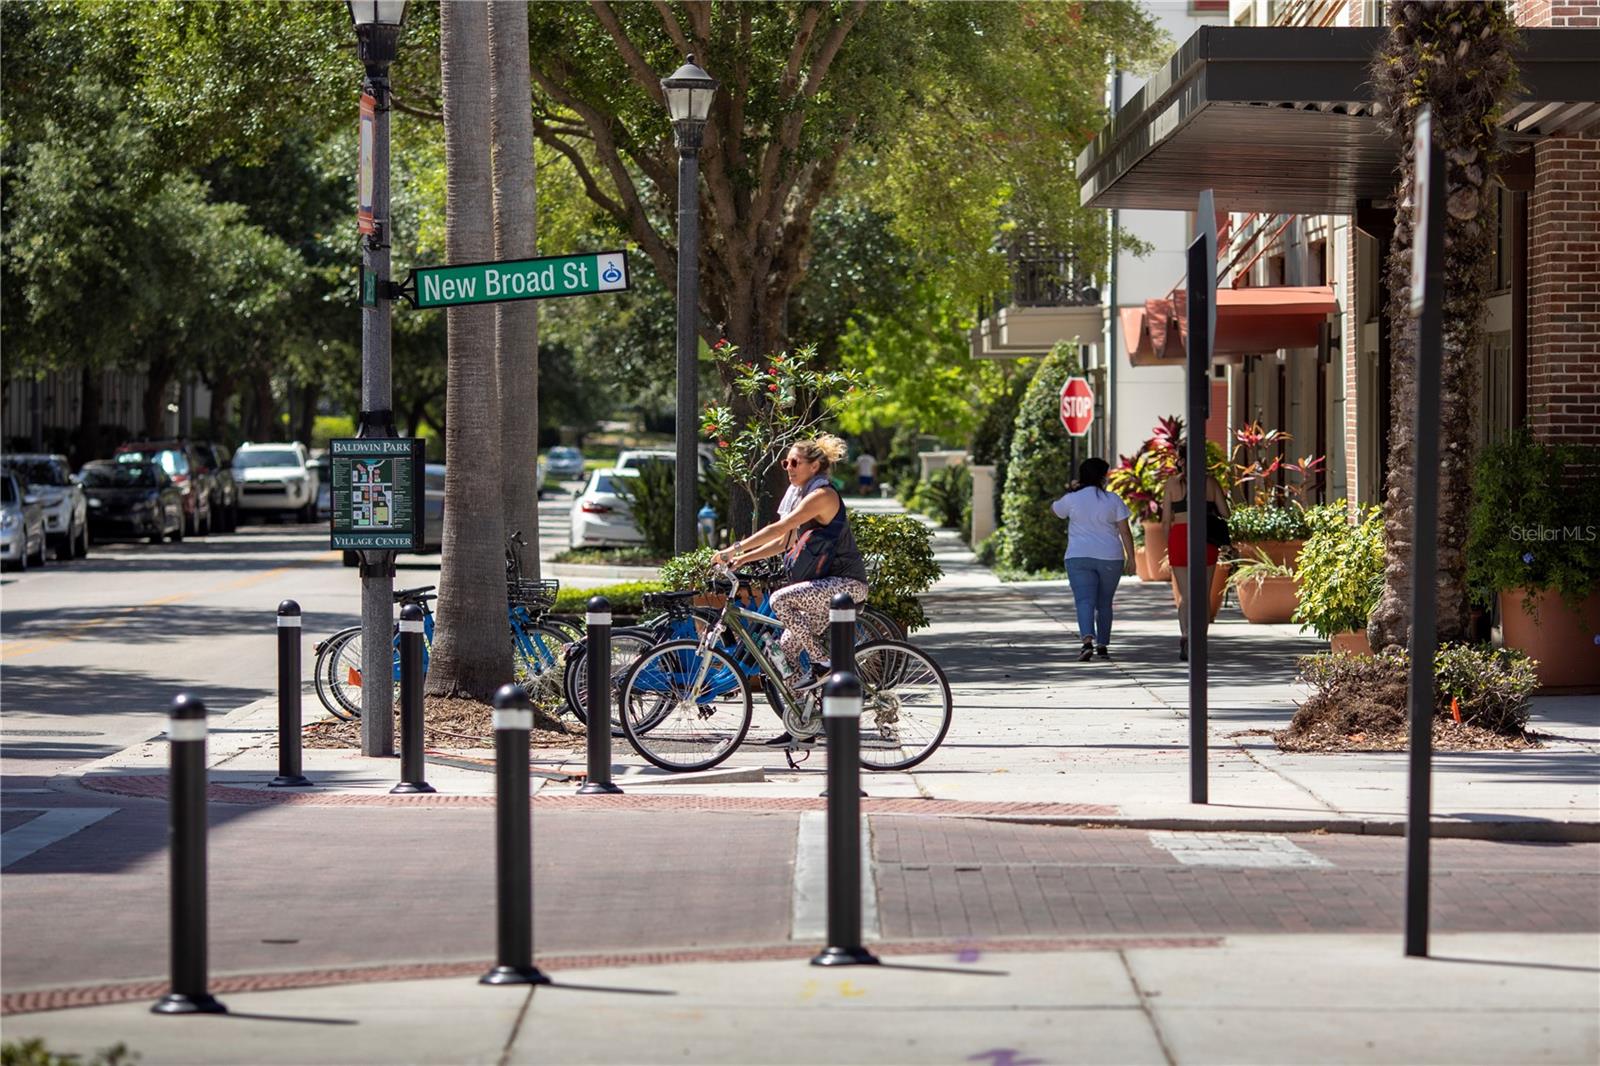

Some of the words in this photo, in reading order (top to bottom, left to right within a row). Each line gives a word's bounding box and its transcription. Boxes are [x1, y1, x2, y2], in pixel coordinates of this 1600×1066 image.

[424, 274, 476, 302] New
[485, 264, 555, 297] Broad
[562, 261, 589, 289] St
[1062, 396, 1091, 418] STOP
[333, 442, 381, 453] BALDWIN
[383, 442, 411, 452] PARK
[334, 537, 373, 546] VILLAGE
[375, 537, 411, 546] CENTER
